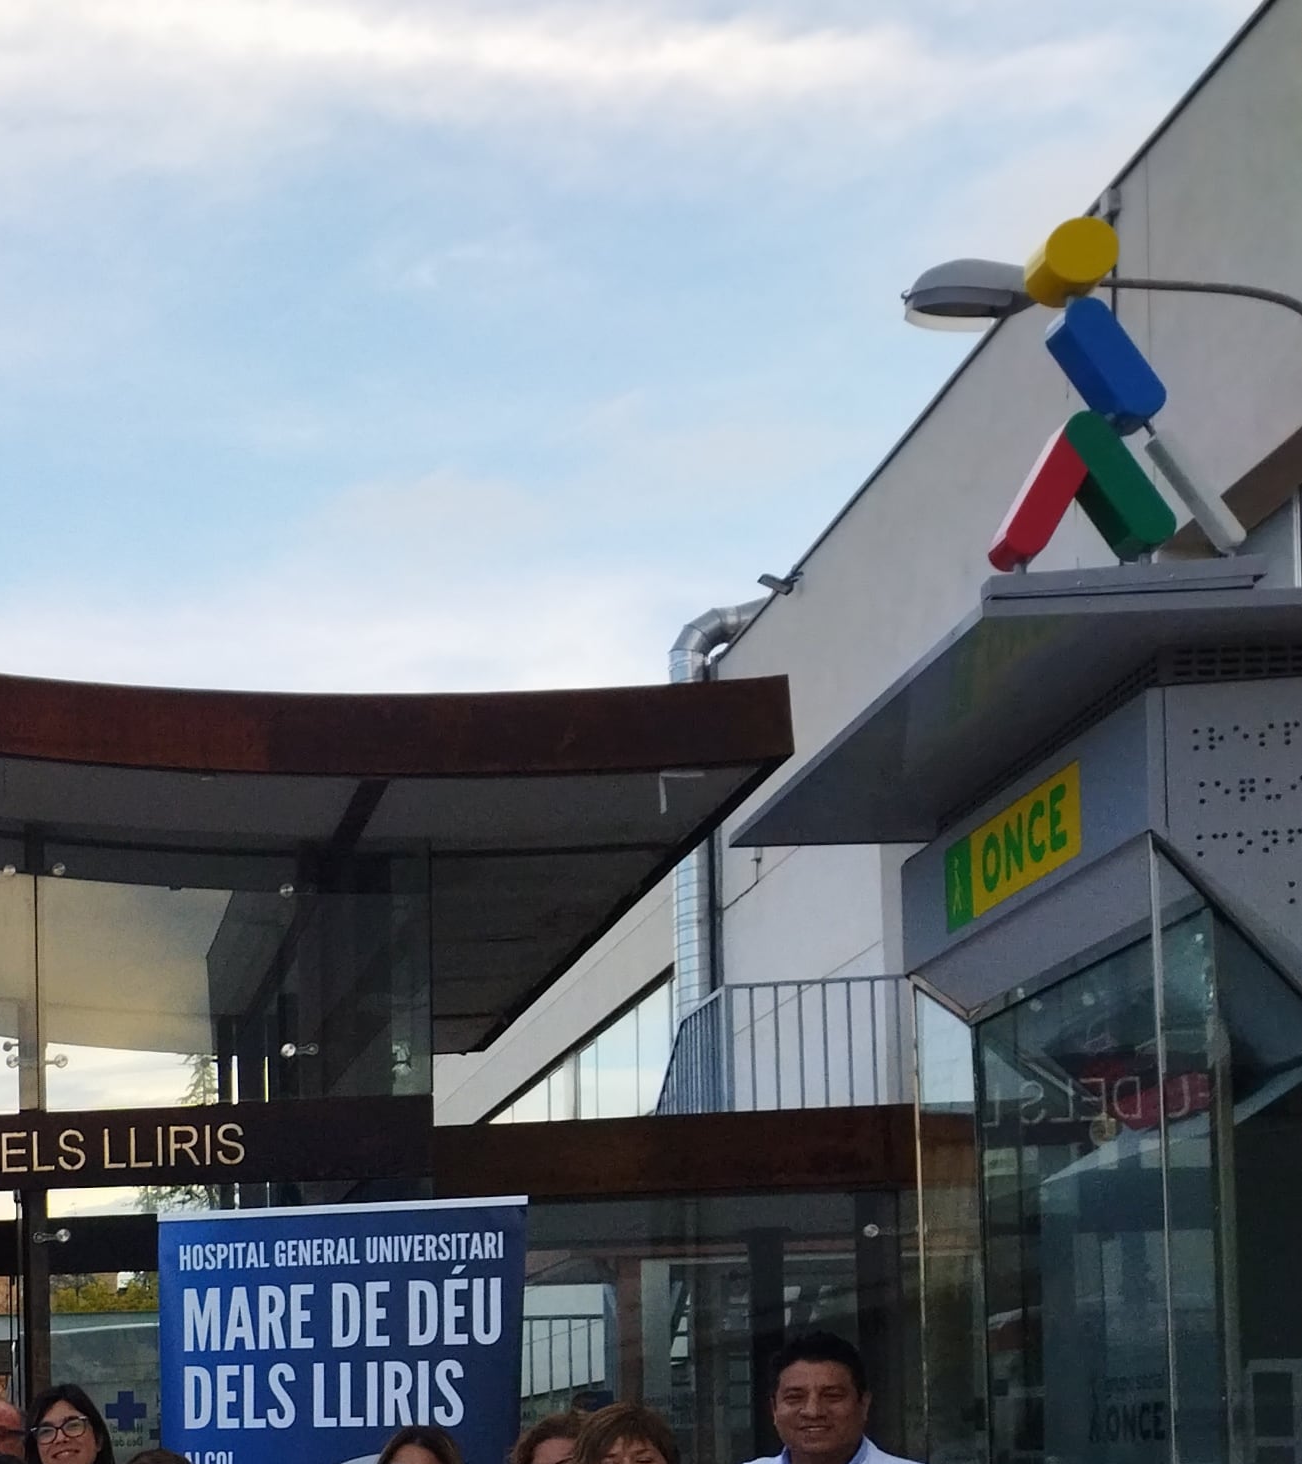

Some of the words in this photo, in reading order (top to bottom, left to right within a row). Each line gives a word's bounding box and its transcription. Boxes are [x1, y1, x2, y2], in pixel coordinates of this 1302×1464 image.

[981, 783, 1067, 893] ONCE
[103, 1122, 245, 1170] LLIRIS
[179, 1241, 270, 1271] HOSPITAL
[274, 1237, 360, 1267] GENERAL
[365, 1231, 504, 1263] UNIVERSITARI
[183, 1284, 315, 1352] MARE
[331, 1281, 390, 1348] DE
[408, 1265, 502, 1346] DÉU
[183, 1362, 297, 1430] DELS
[313, 1360, 464, 1428] LLIRIS
